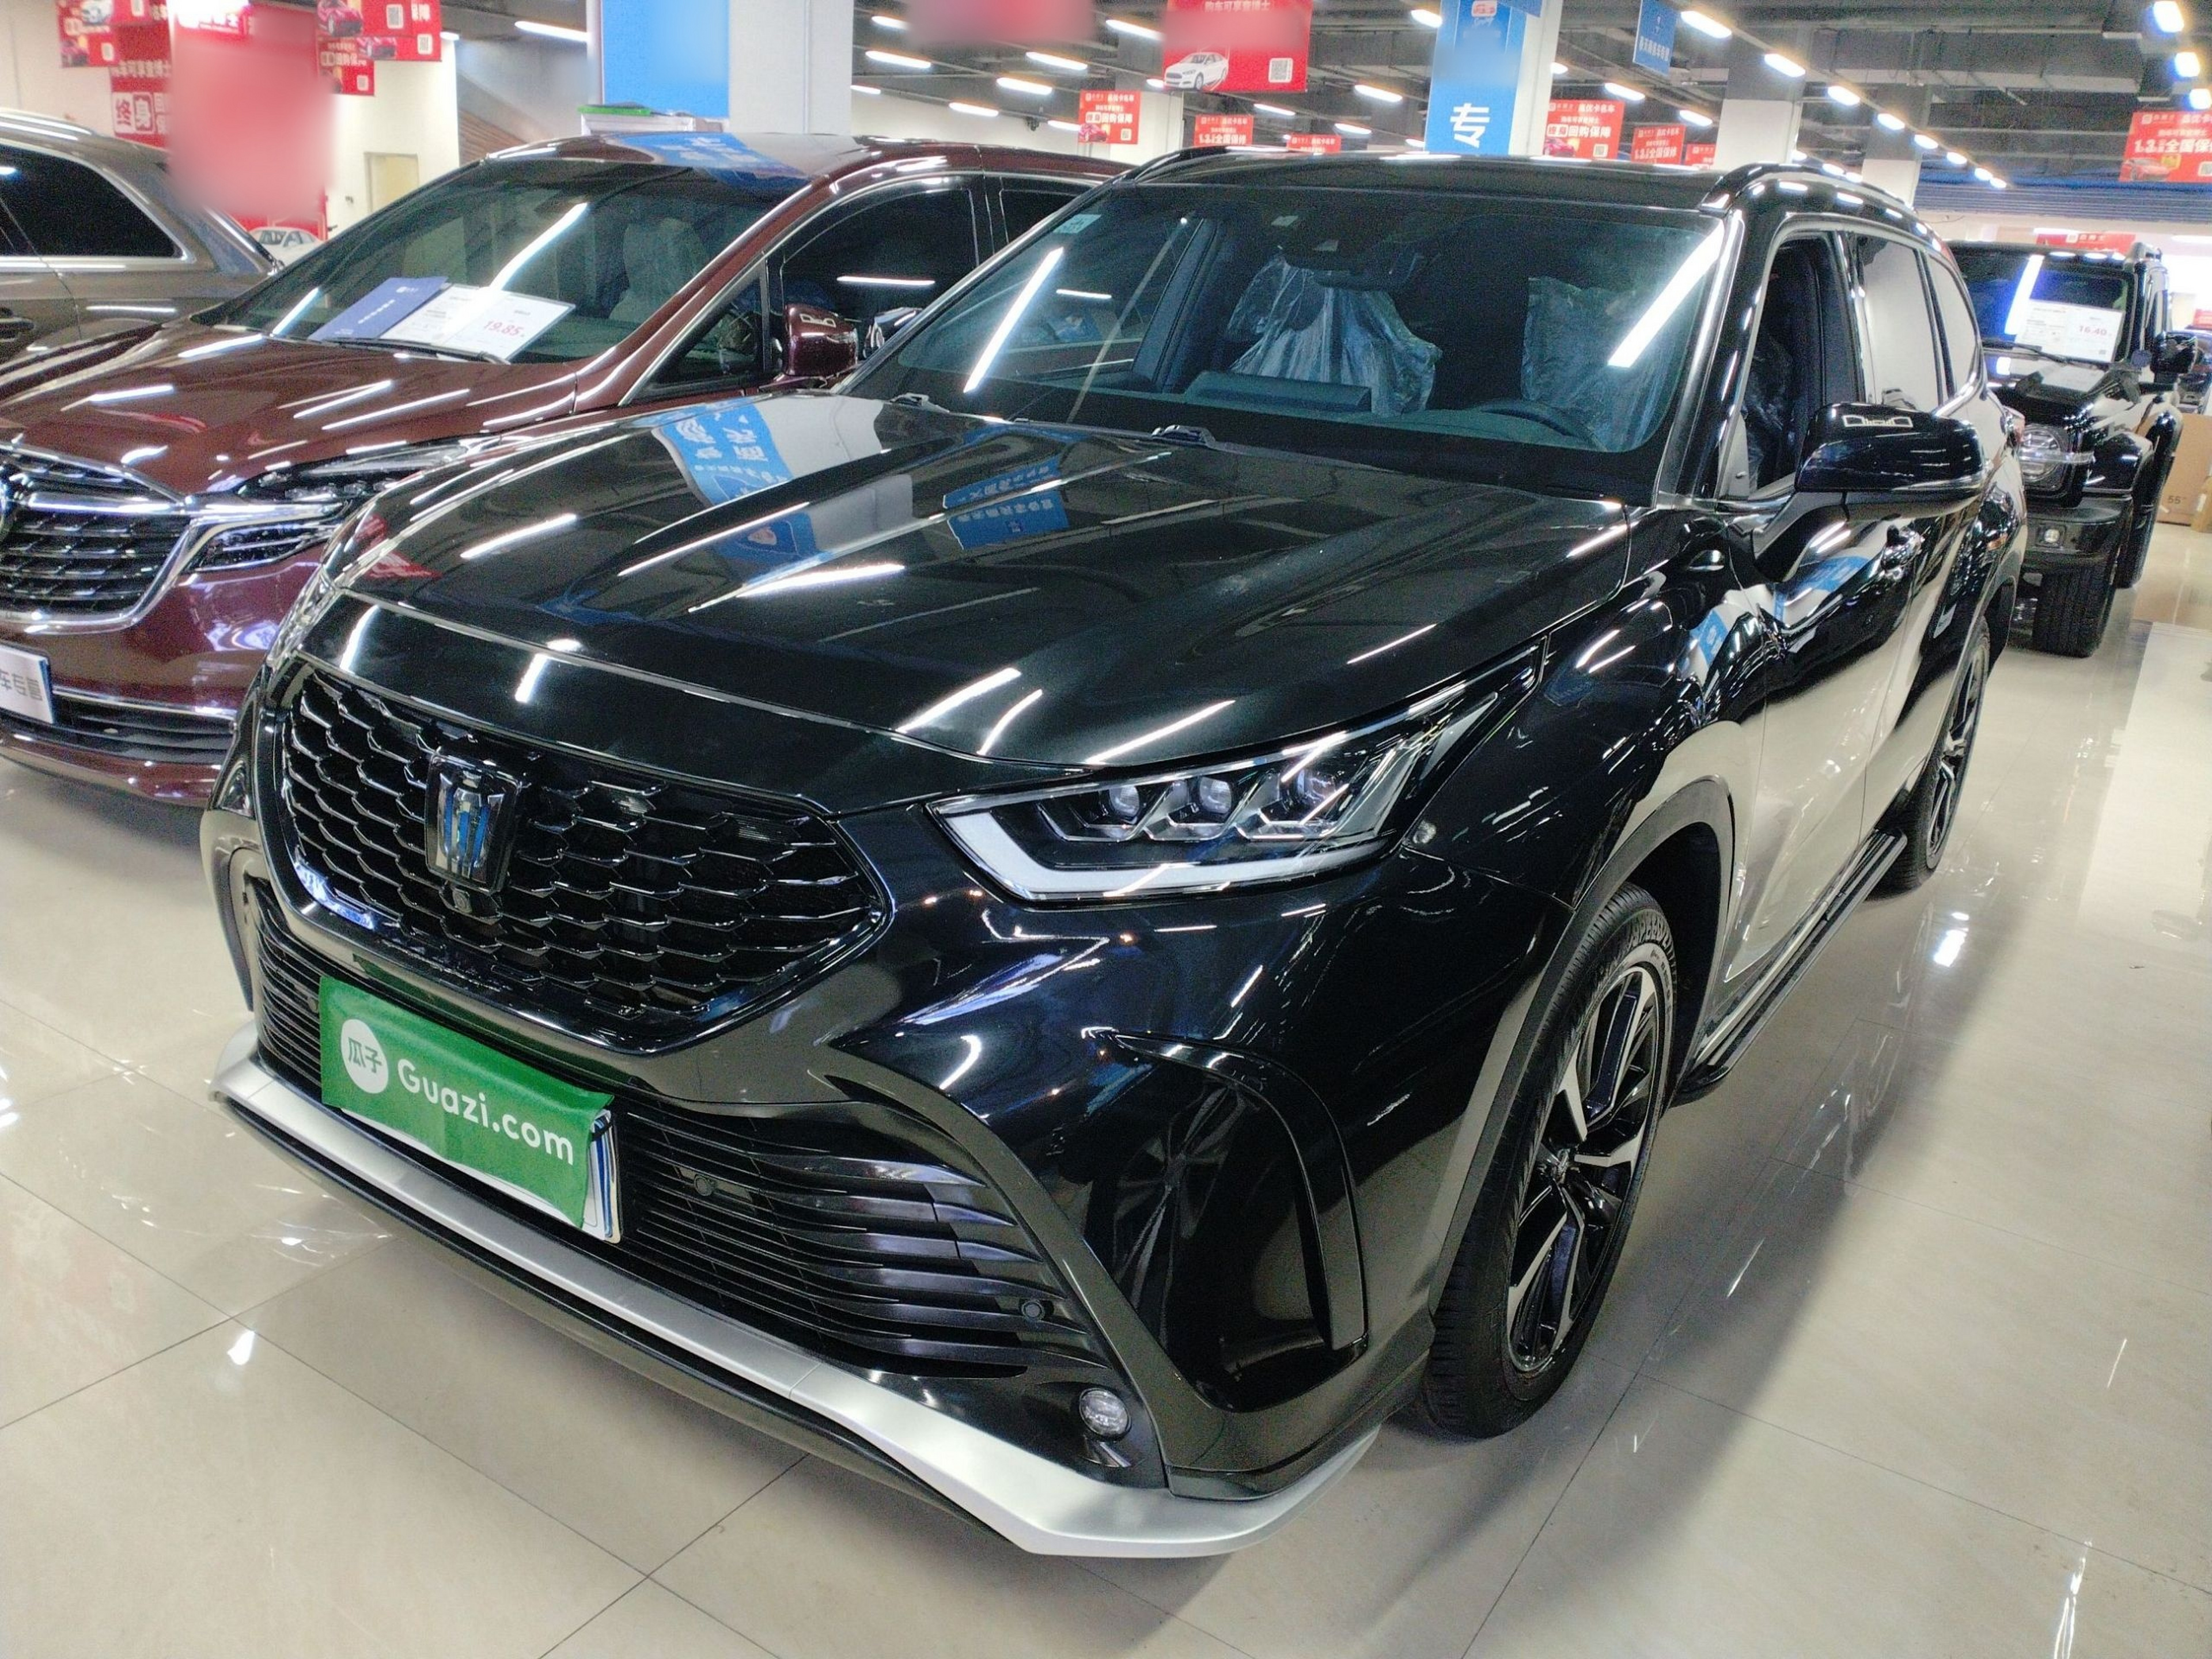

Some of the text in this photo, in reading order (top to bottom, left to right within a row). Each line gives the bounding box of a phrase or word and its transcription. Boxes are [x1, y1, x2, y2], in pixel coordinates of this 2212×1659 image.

[1449, 103, 1491, 149] 专
[484, 320, 522, 337] 19.85
[2079, 325, 2107, 336] 16.40
[347, 1037, 574, 1166] 瓜子 Guazi.com
